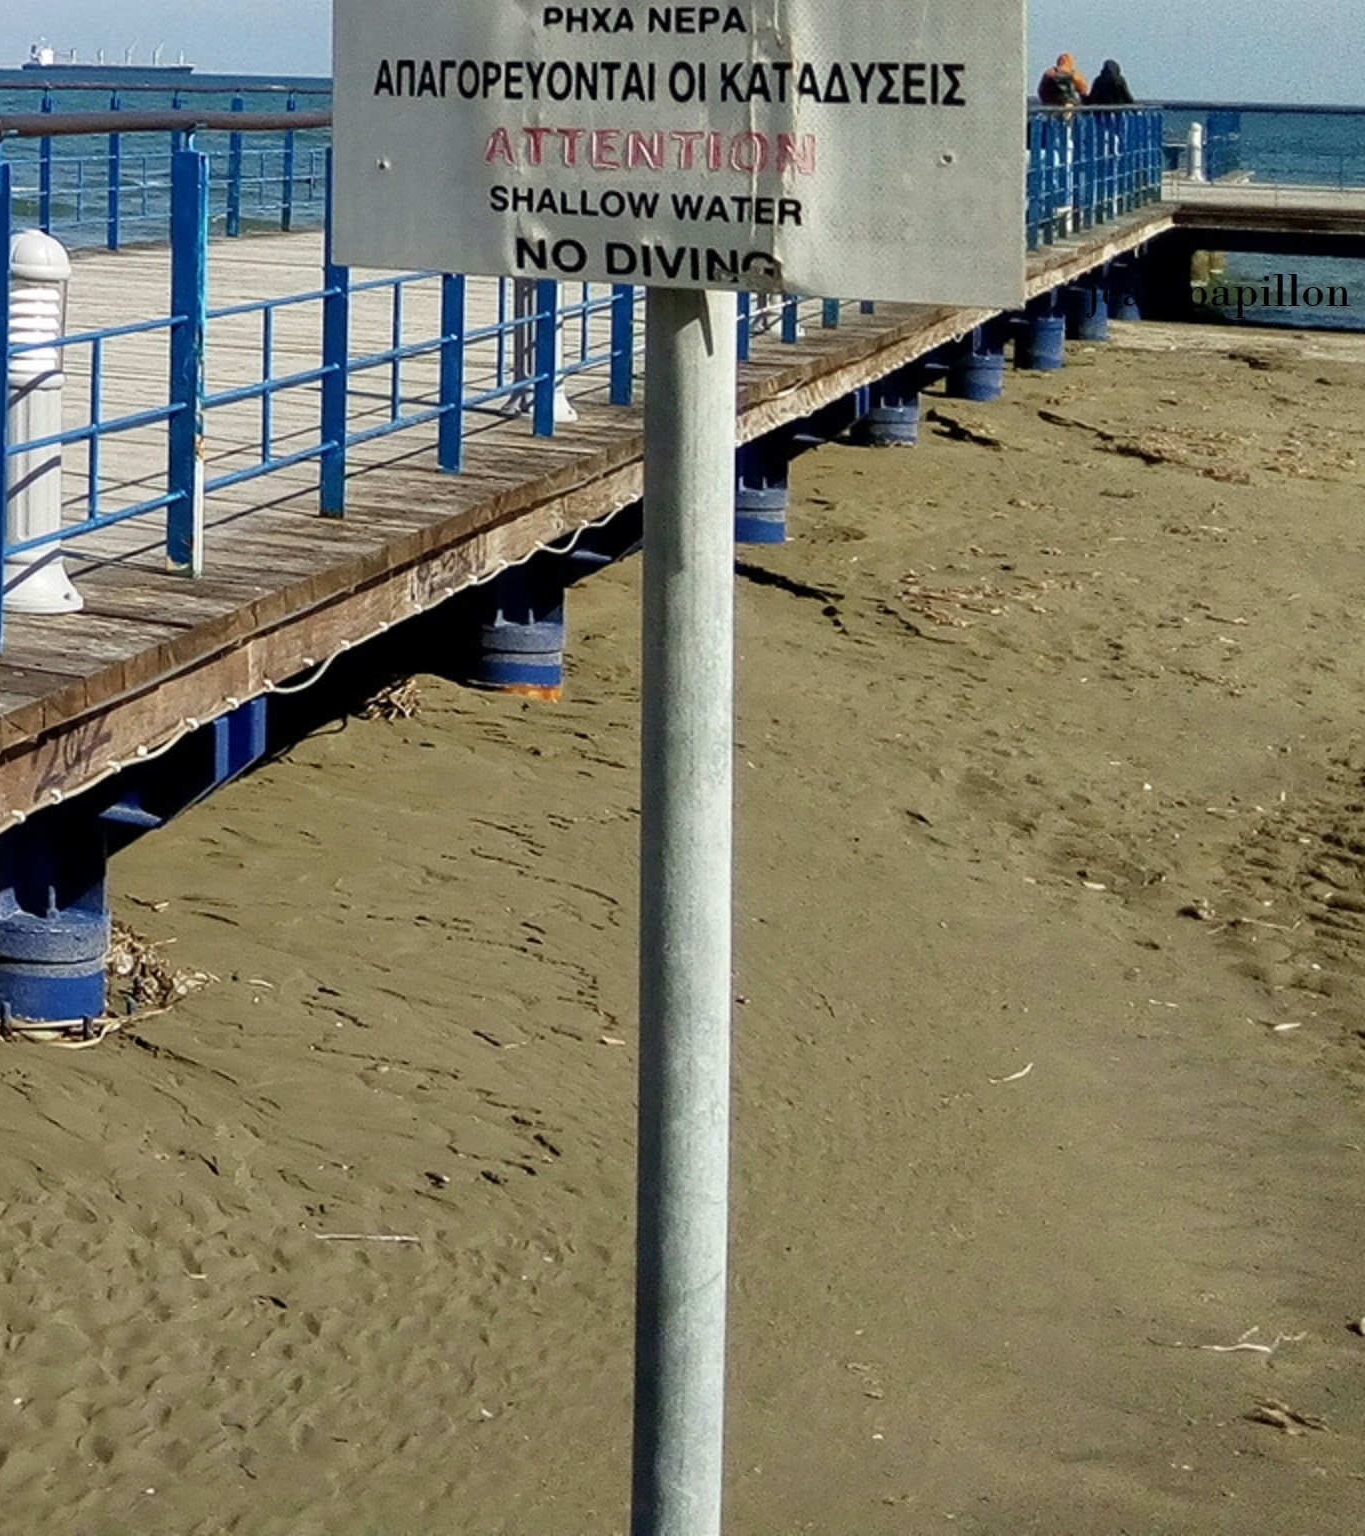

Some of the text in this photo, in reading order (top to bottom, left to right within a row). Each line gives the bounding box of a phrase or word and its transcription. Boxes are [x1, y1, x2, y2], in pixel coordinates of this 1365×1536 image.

[542, 6, 748, 34] ΡΗΧΑ ΝΕΡΑ
[373, 58, 967, 107] ΑΠΑΓΟΡΕΥΟΝΤΑΙ ΟΙ ΚΑΤΑΔΥΣΕΙΣ
[482, 125, 817, 176] ATTENTION
[489, 184, 803, 227] SHALLOW WATER
[516, 236, 588, 274] NO
